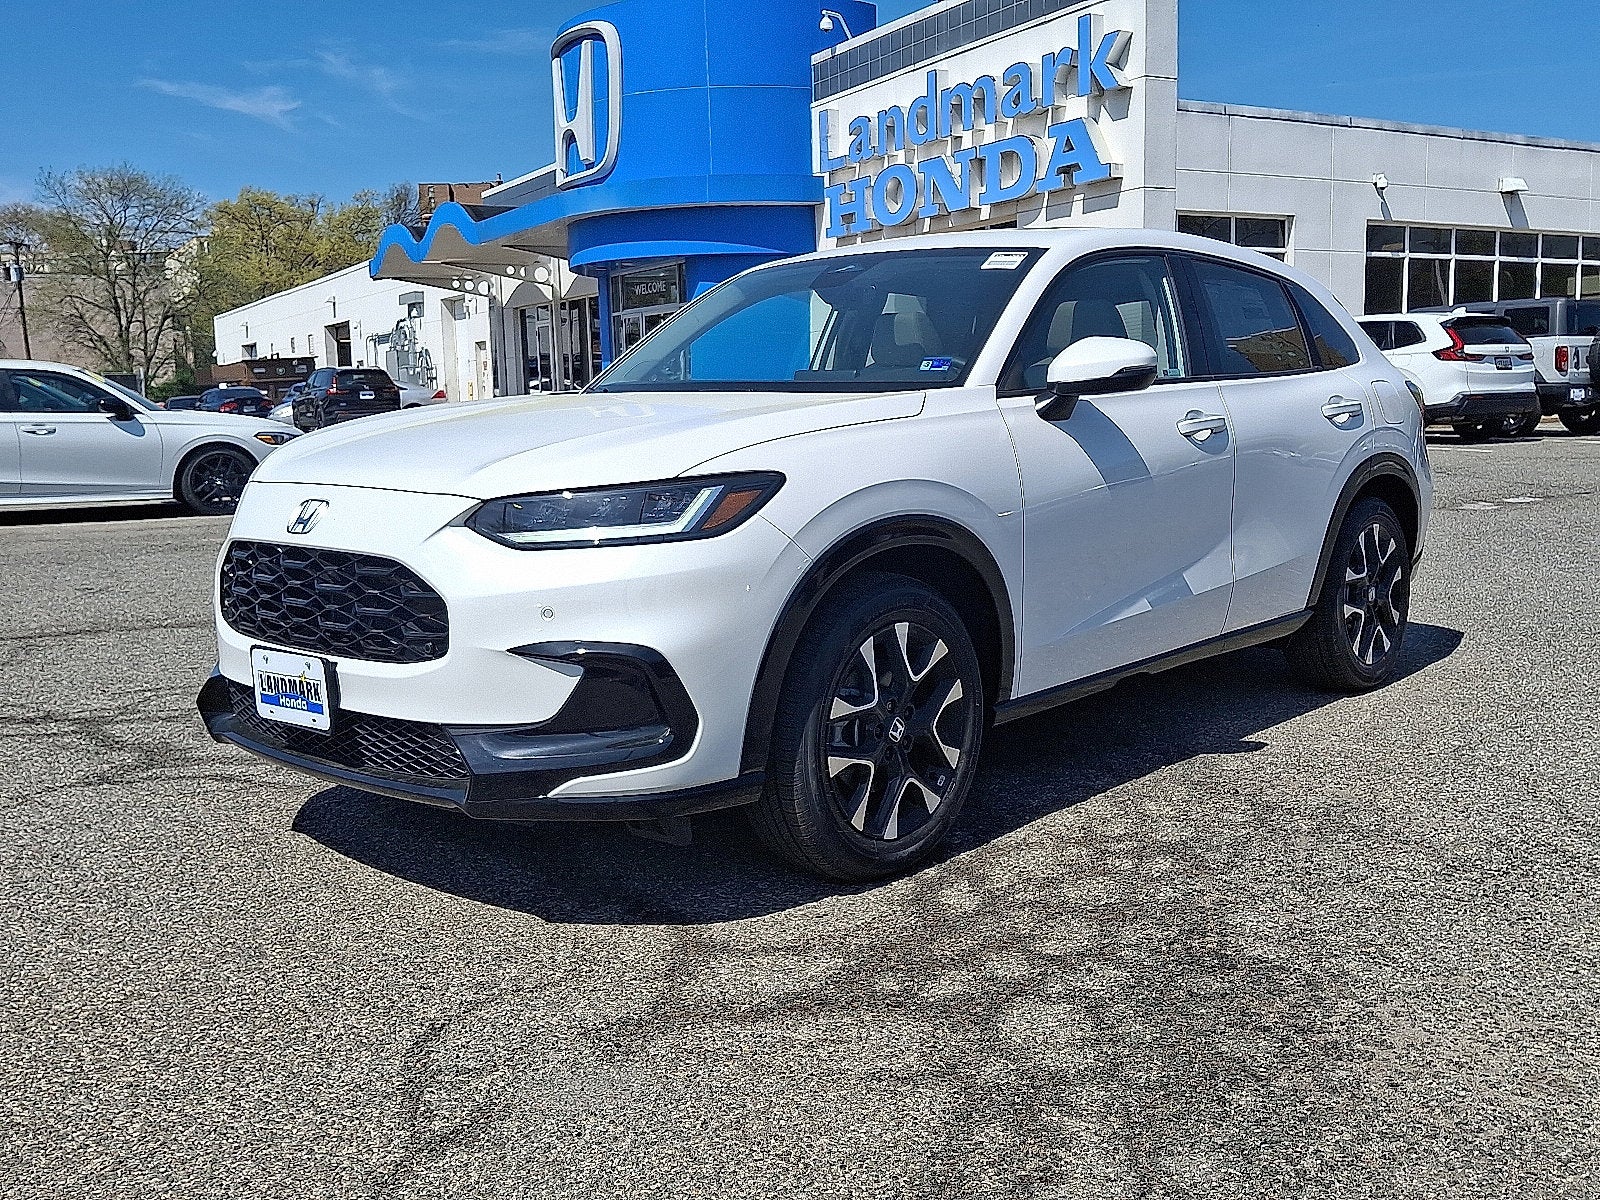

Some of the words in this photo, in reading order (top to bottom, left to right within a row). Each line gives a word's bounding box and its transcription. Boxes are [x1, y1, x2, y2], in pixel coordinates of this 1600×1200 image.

[819, 13, 1122, 173] Landmark
[824, 117, 1112, 239] HONDA
[634, 281, 667, 295] WELCOME
[259, 673, 323, 703] LANDMARK
[280, 694, 308, 711] Honda
